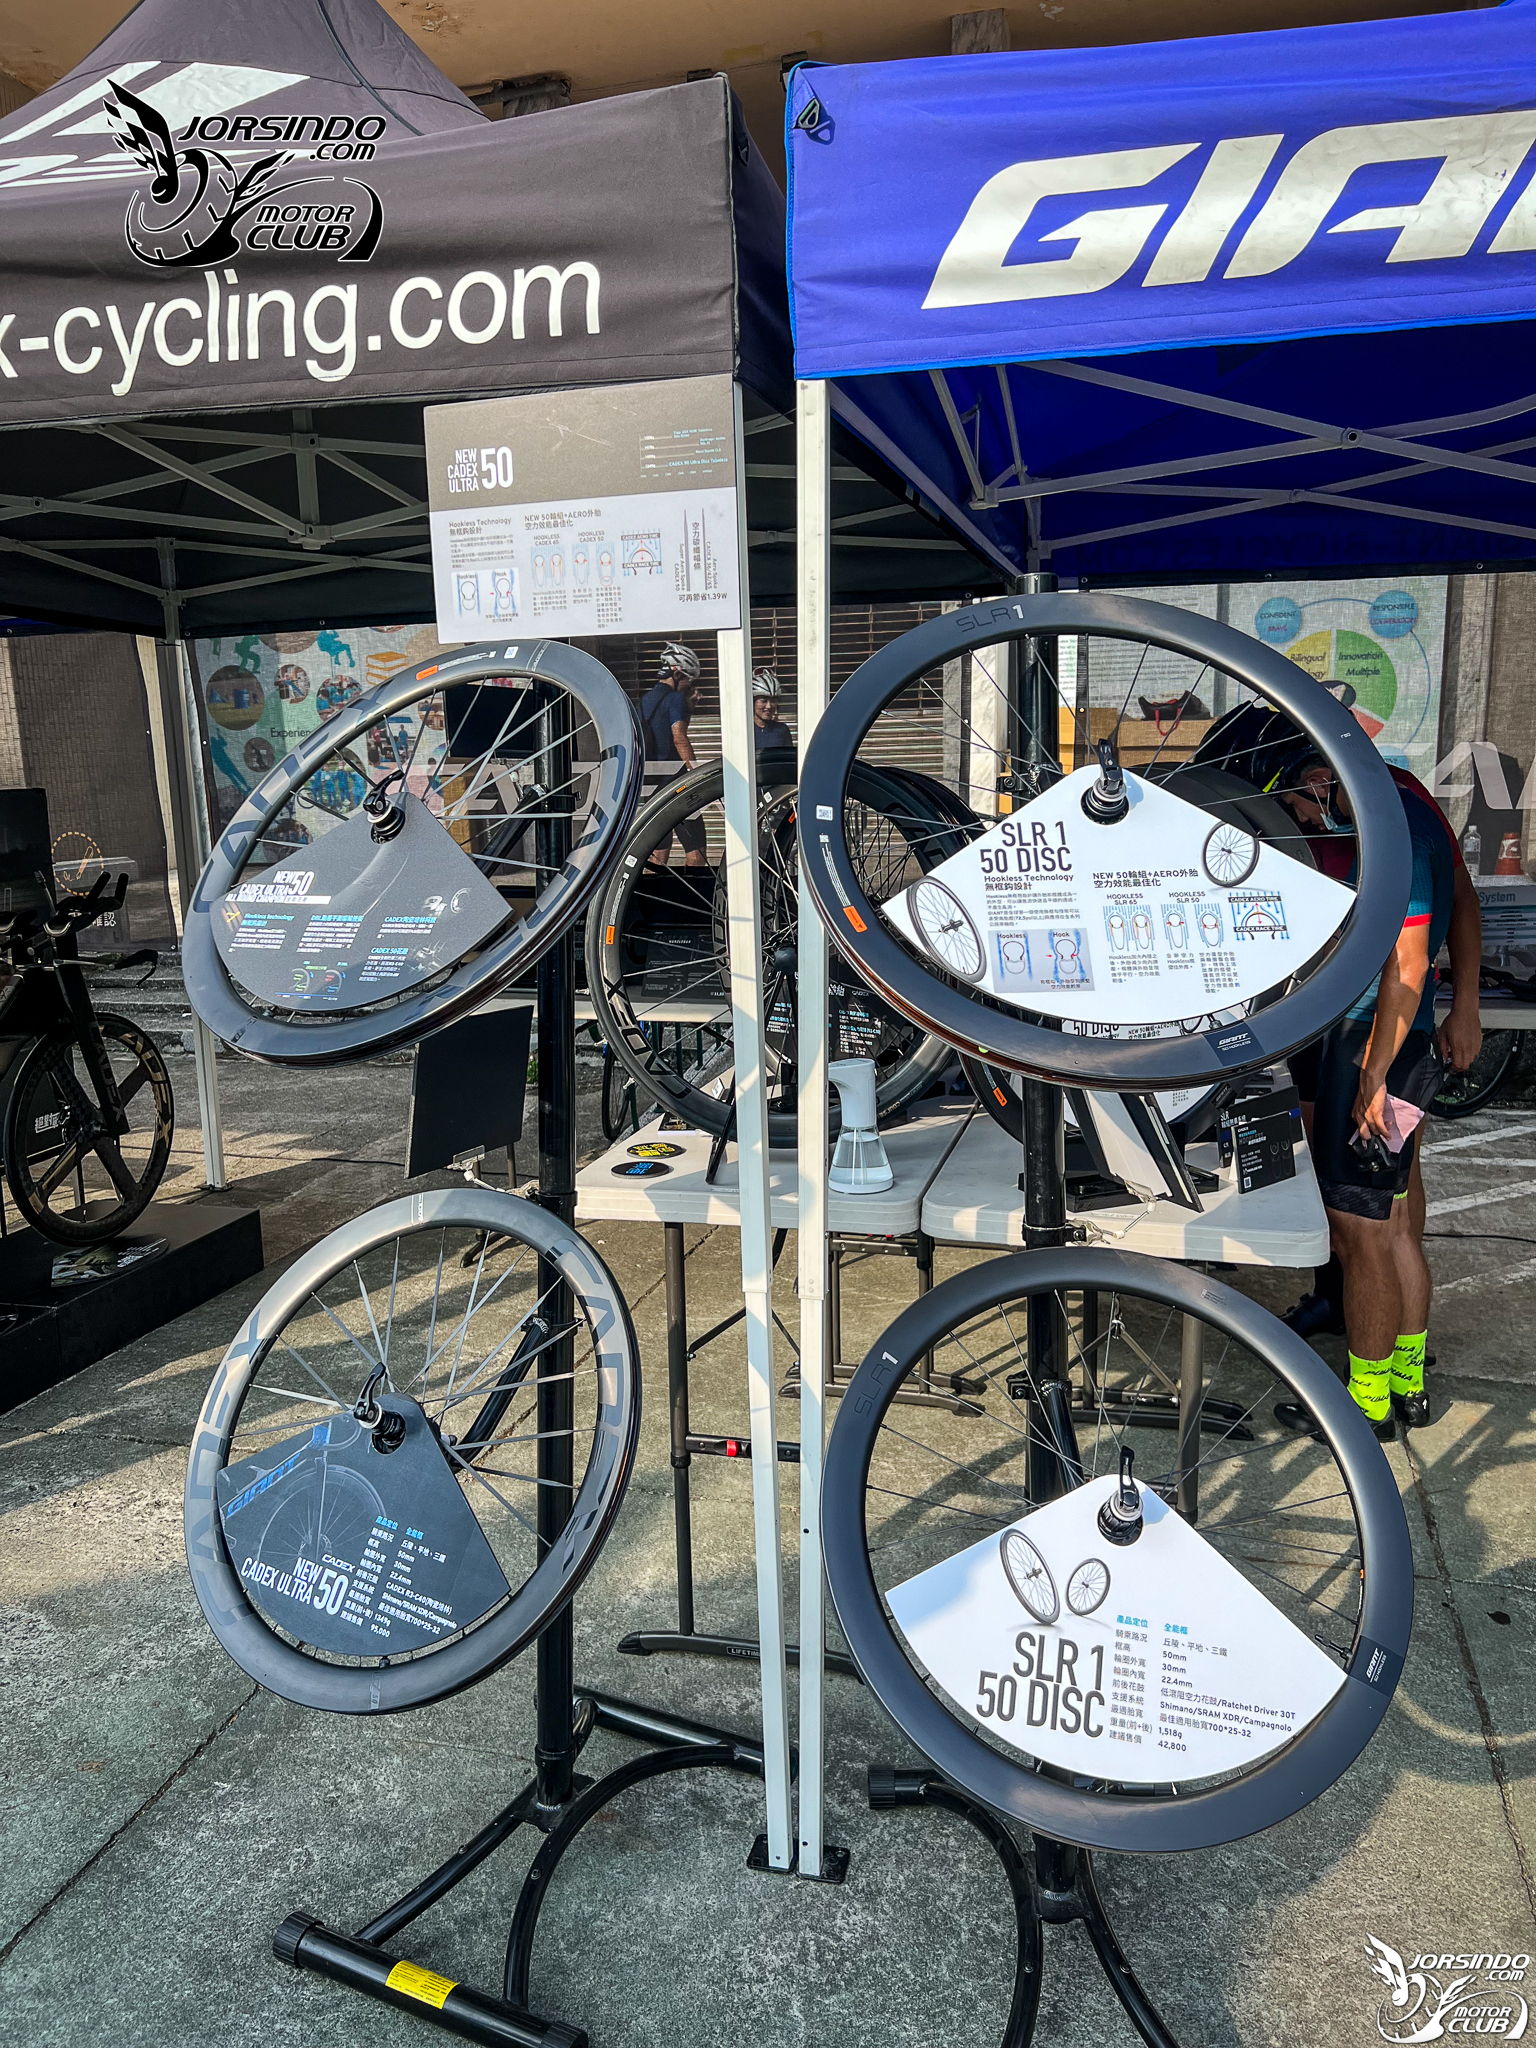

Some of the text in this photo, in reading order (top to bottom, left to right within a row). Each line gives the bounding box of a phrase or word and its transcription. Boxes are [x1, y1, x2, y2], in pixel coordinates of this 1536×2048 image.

[920, 109, 1536, 311] GIA
[455, 448, 478, 465] NEW
[447, 463, 479, 479] CADEX
[480, 446, 514, 489] 50
[449, 477, 480, 493] ULTRA
[449, 517, 512, 528] Hookless Technology
[524, 514, 540, 522] NEW
[578, 530, 605, 538] HOOKLESS
[1290, 652, 1327, 664] Bilingual
[1338, 652, 1383, 661] Innovation
[1346, 666, 1381, 678] Multiple
[1001, 820, 1067, 847] SLR 1
[979, 846, 1073, 874] 50 DISC
[273, 871, 295, 883] NEW
[984, 873, 1074, 883] Hookless Technology
[1092, 868, 1199, 881] NEW 50輪組+AERO外胎
[239, 884, 290, 896] CADEX ULTRA
[288, 871, 315, 895] 50
[1093, 878, 1162, 889] 空力效能最佳化
[1168, 890, 1206, 899] HOOKLESS
[1478, 891, 1516, 903] System
[371, 947, 390, 955] CADEX
[226, 1454, 300, 1519] GIANT
[321, 1553, 356, 1574] CADEX
[397, 1549, 416, 1563] 50mm
[292, 1557, 320, 1585] NEW
[393, 1560, 412, 1574] 30mm
[240, 1557, 314, 1605] CADEX ULTRA
[389, 1570, 413, 1586] 22.4mm
[313, 1567, 349, 1616] 50
[385, 1581, 407, 1596] CADEX
[370, 1623, 391, 1638] 95,000
[1116, 1614, 1189, 1636] 產品定位 全能框
[731, 1648, 760, 1657] LIFETIM
[1114, 1641, 1188, 1662] 框高 50mm
[1012, 1631, 1105, 1691] SLR 1
[1113, 1653, 1187, 1675] 輪圈外寬 30mm
[1161, 1675, 1194, 1689] 22.4mm
[976, 1670, 1106, 1739] 50 DISC
[1112, 1678, 1145, 1693] 前後花鼓
[1253, 1705, 1280, 1718] Driver
[1280, 1710, 1296, 1720] 30T
[1110, 1704, 1144, 1719] 最適胎寬
[1111, 1691, 1293, 1733] 支援系統 Shimano/SRAM XDR/Campagnolo
[1109, 1716, 1183, 1740] 重量(前+後) 1,518g
[1109, 1729, 1187, 1752] 建議售價 42,800
